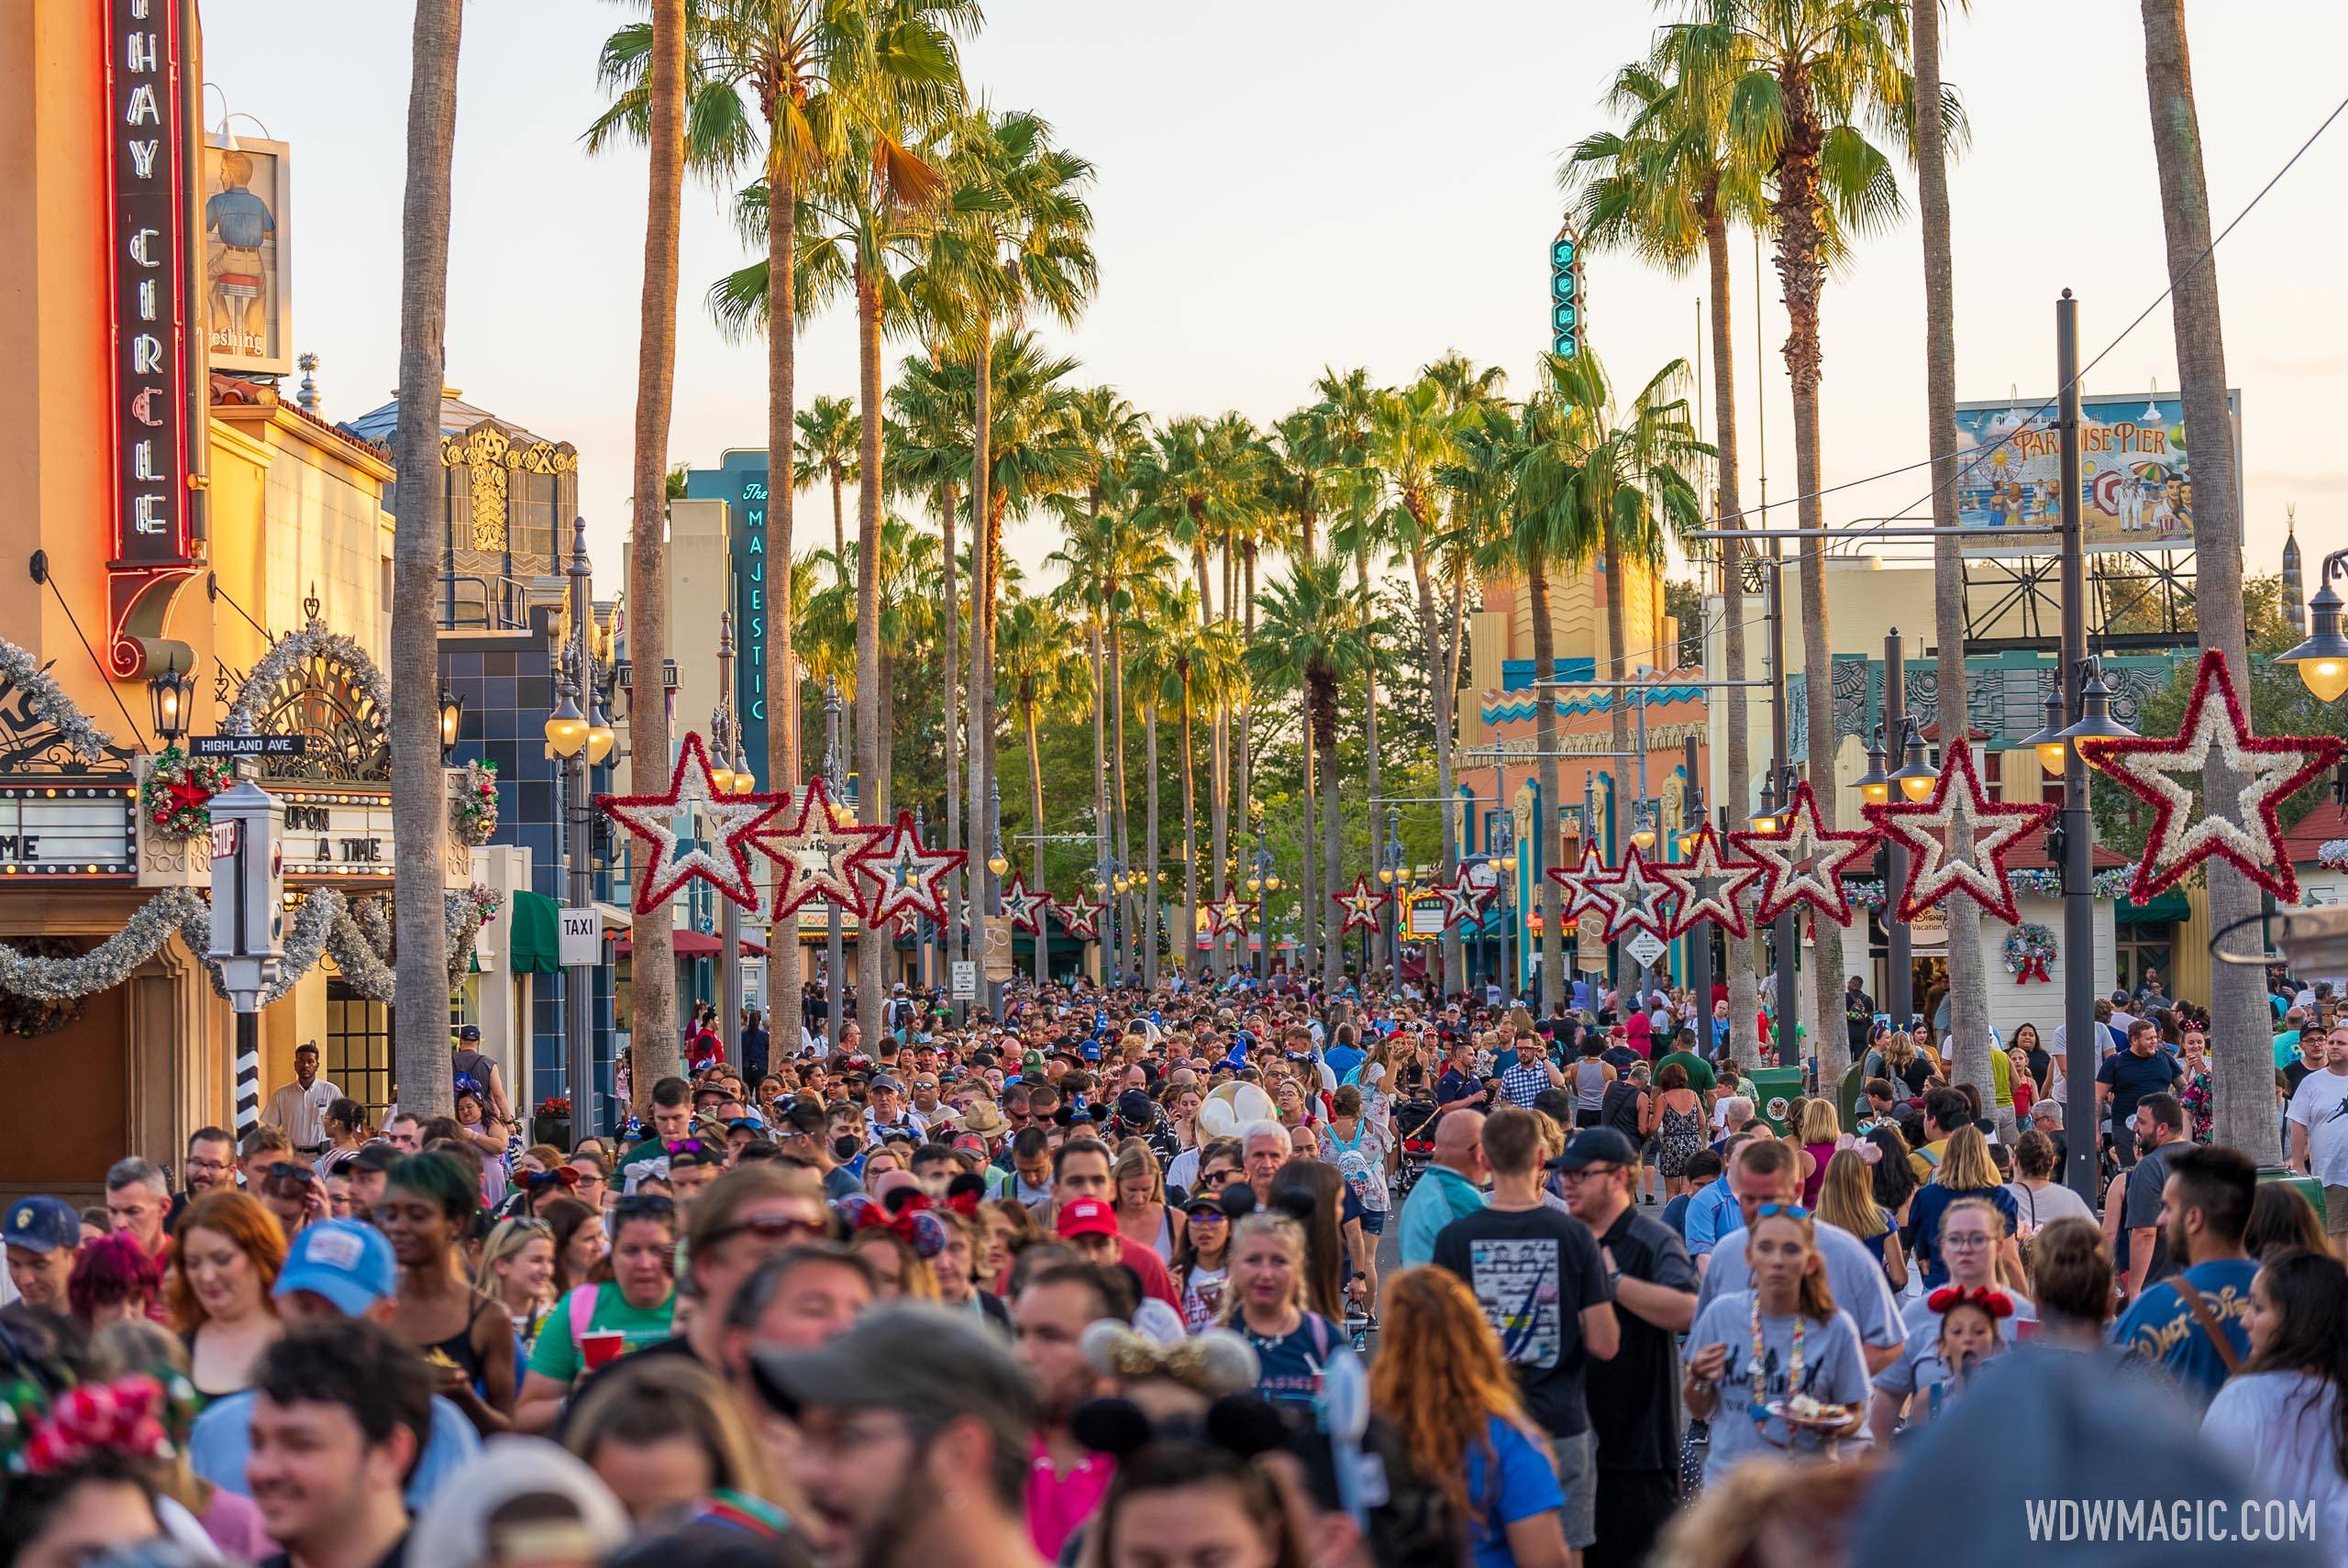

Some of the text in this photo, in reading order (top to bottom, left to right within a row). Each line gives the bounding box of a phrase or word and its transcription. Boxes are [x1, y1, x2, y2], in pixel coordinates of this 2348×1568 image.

[129, 227, 166, 535] CIRCLE
[2013, 422, 2166, 461] PARISE PIER
[742, 483, 769, 500] The
[748, 510, 764, 720] MAJESTIC
[201, 739, 294, 752] HIGHLAND AVE.
[284, 805, 330, 832] UPON
[0, 834, 40, 861] ME
[212, 822, 235, 857] STOP
[318, 836, 382, 863] A TIME
[563, 919, 593, 935] TAXI
[1578, 918, 1605, 945] 50
[1911, 922, 1944, 931] Vacation
